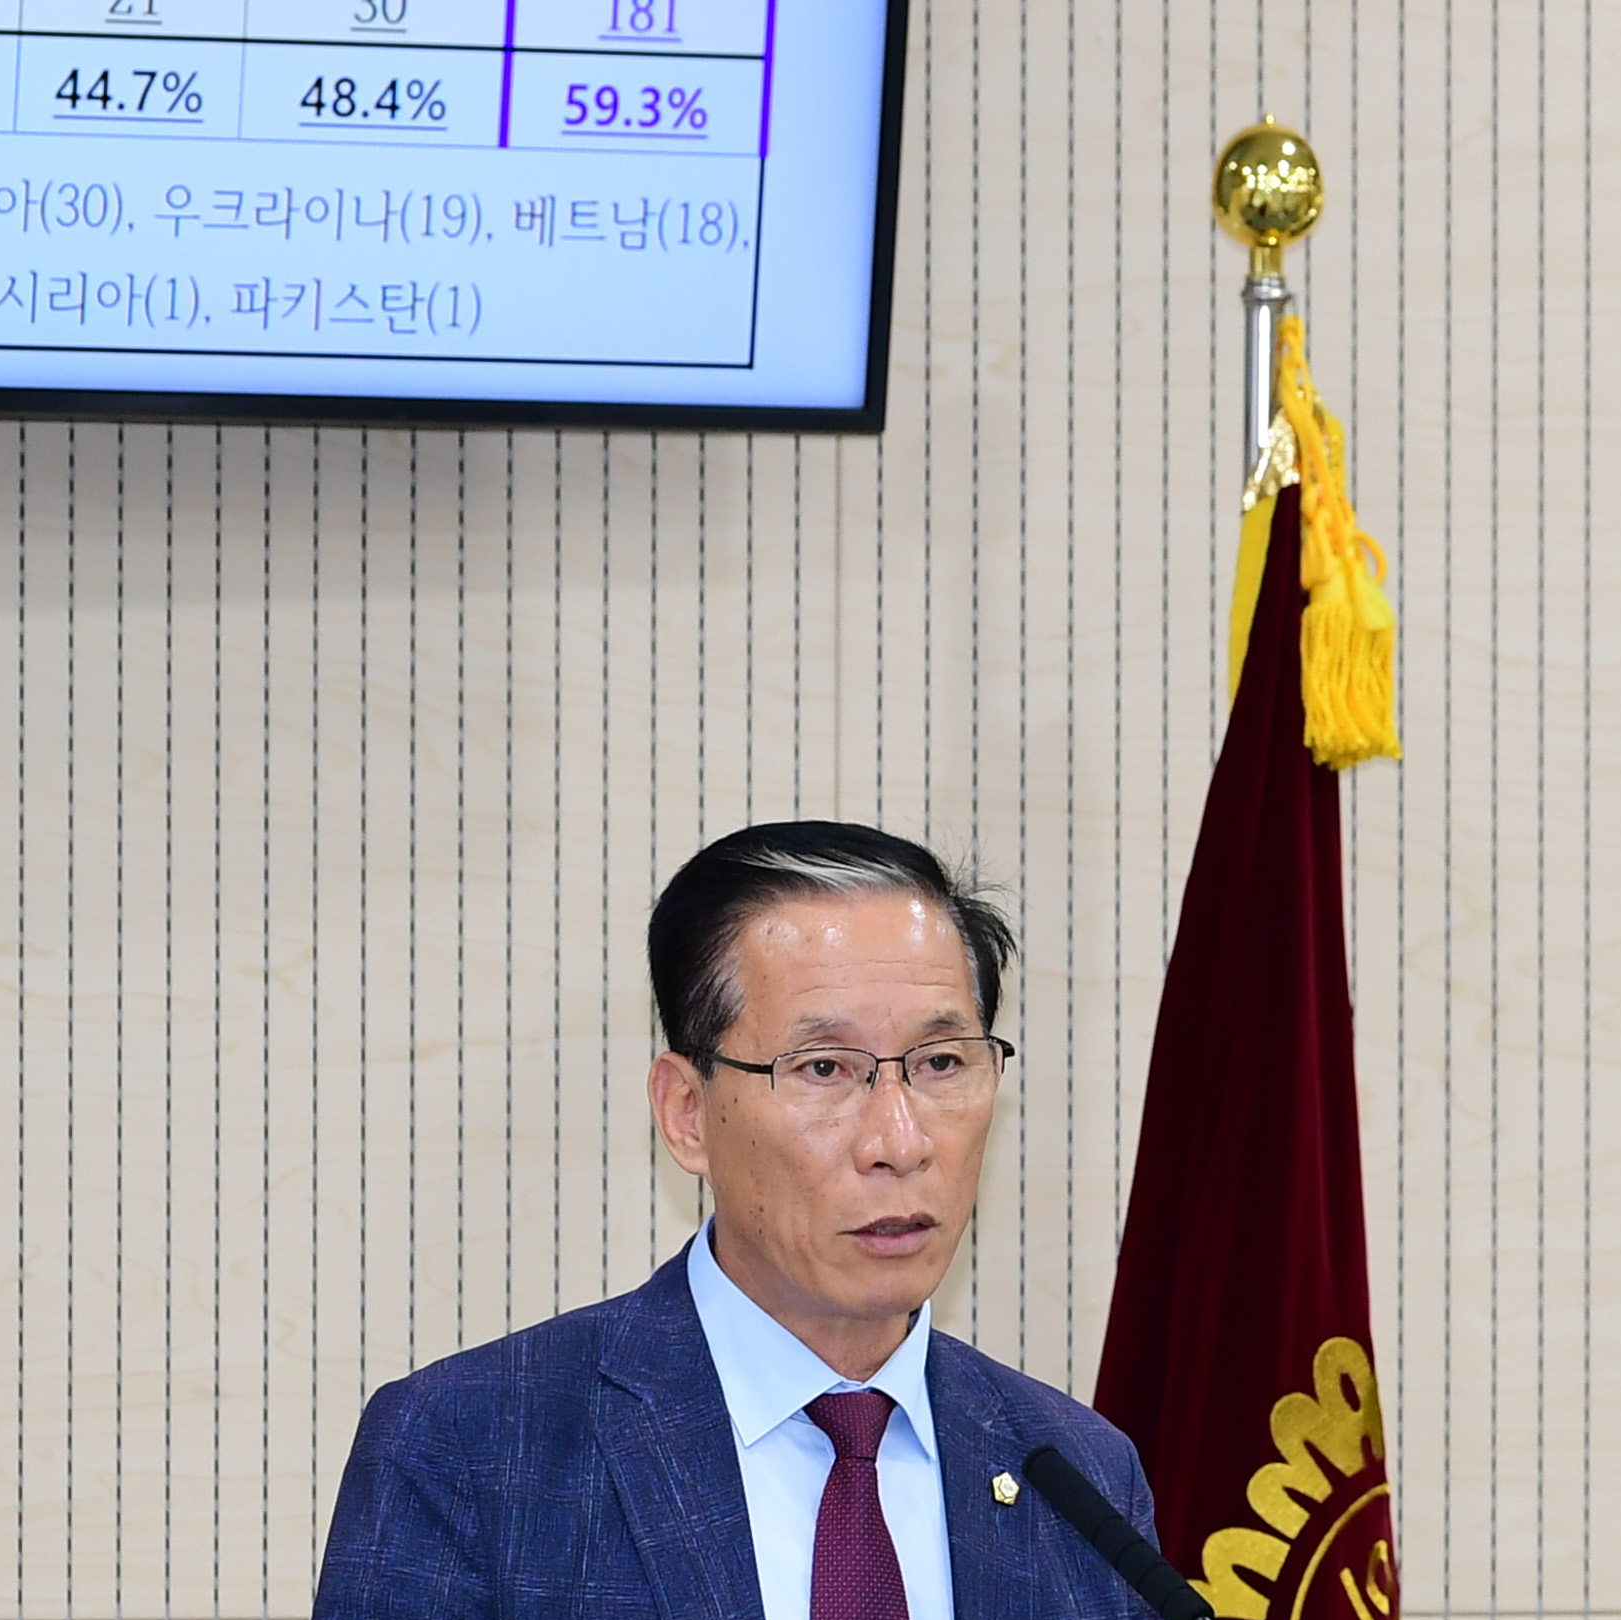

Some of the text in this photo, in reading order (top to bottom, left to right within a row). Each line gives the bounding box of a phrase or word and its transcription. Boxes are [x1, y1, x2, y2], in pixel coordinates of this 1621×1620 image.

[55, 67, 203, 114] 44.7%
[299, 75, 447, 121] 48.4%
[563, 83, 708, 130] 59.3%
[155, 183, 493, 245] 우크라이나(19),
[514, 194, 750, 253] 베트남(18),
[231, 277, 482, 335] 파키스탄(1)
